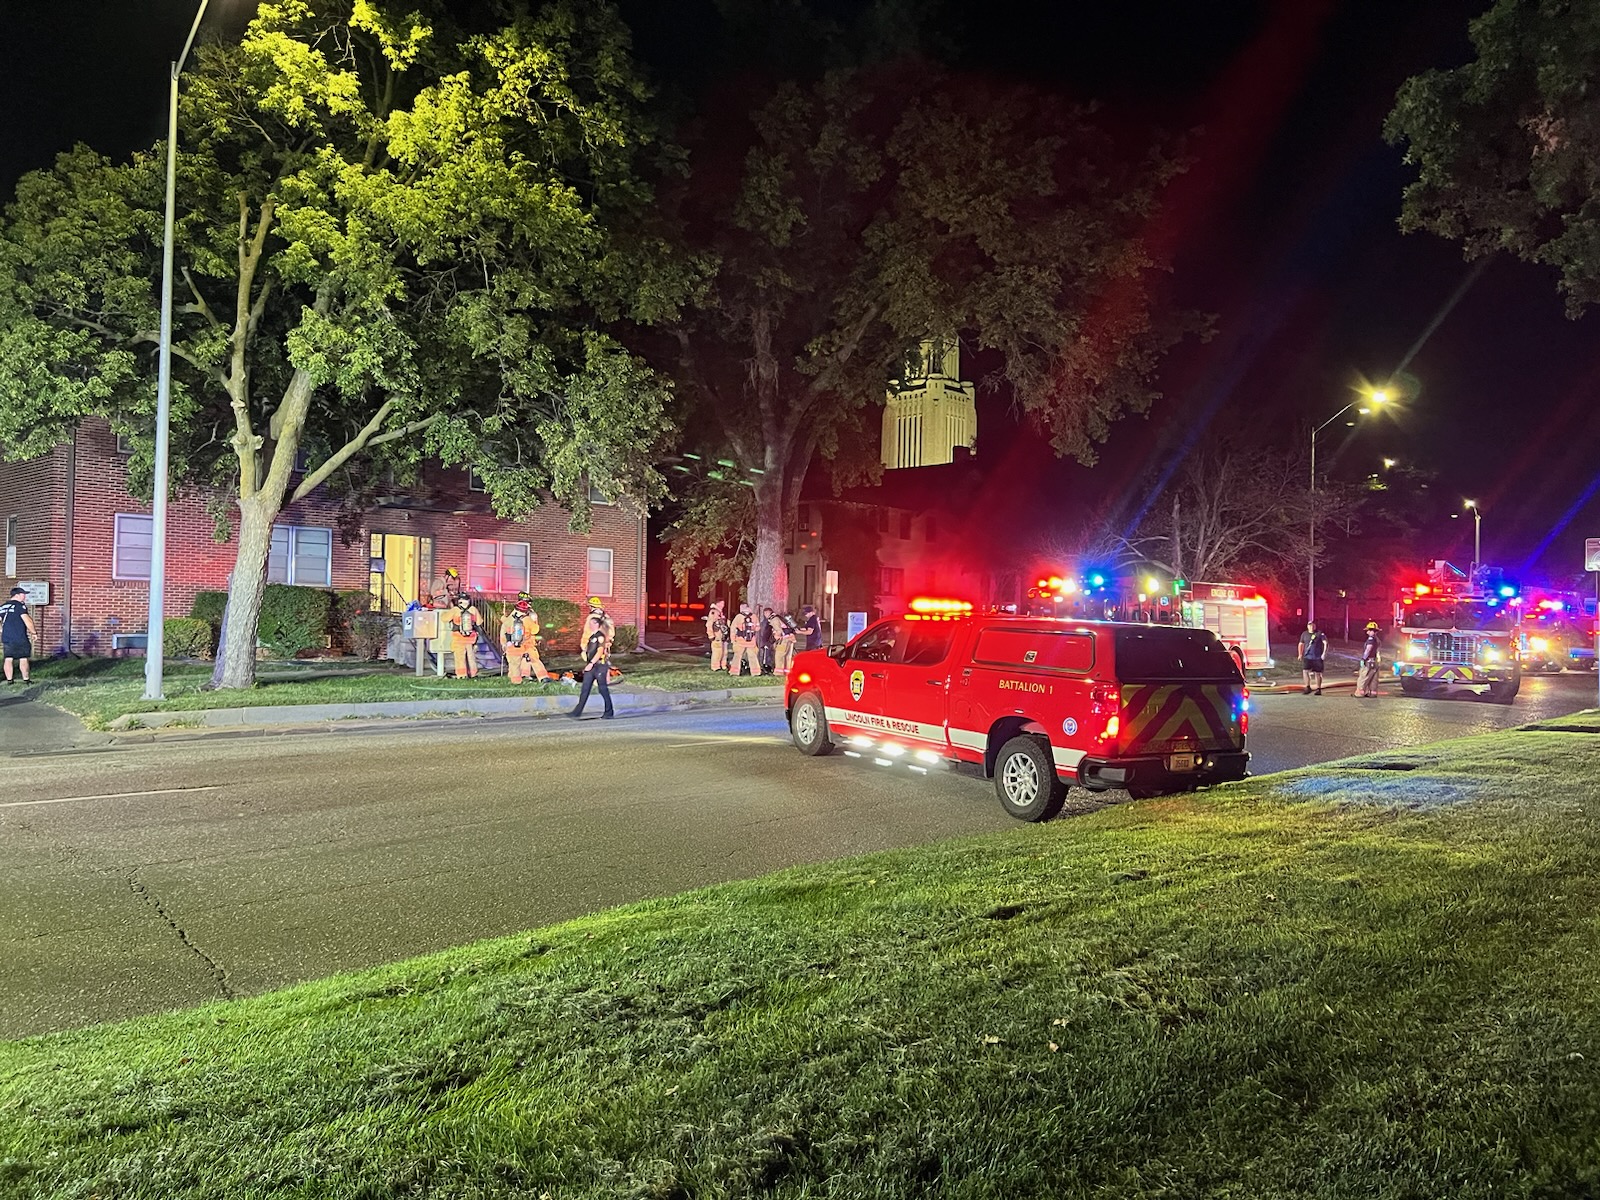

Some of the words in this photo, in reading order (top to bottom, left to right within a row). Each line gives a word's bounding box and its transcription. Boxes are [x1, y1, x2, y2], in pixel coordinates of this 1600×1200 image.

[1211, 589, 1227, 598] ENGINE
[999, 679, 1046, 693] BATTALION
[1049, 685, 1053, 694] 1
[844, 712, 870, 725] LINCOLN
[870, 717, 886, 728] FIRE
[886, 720, 892, 729] &
[892, 721, 920, 734] RESCUE
